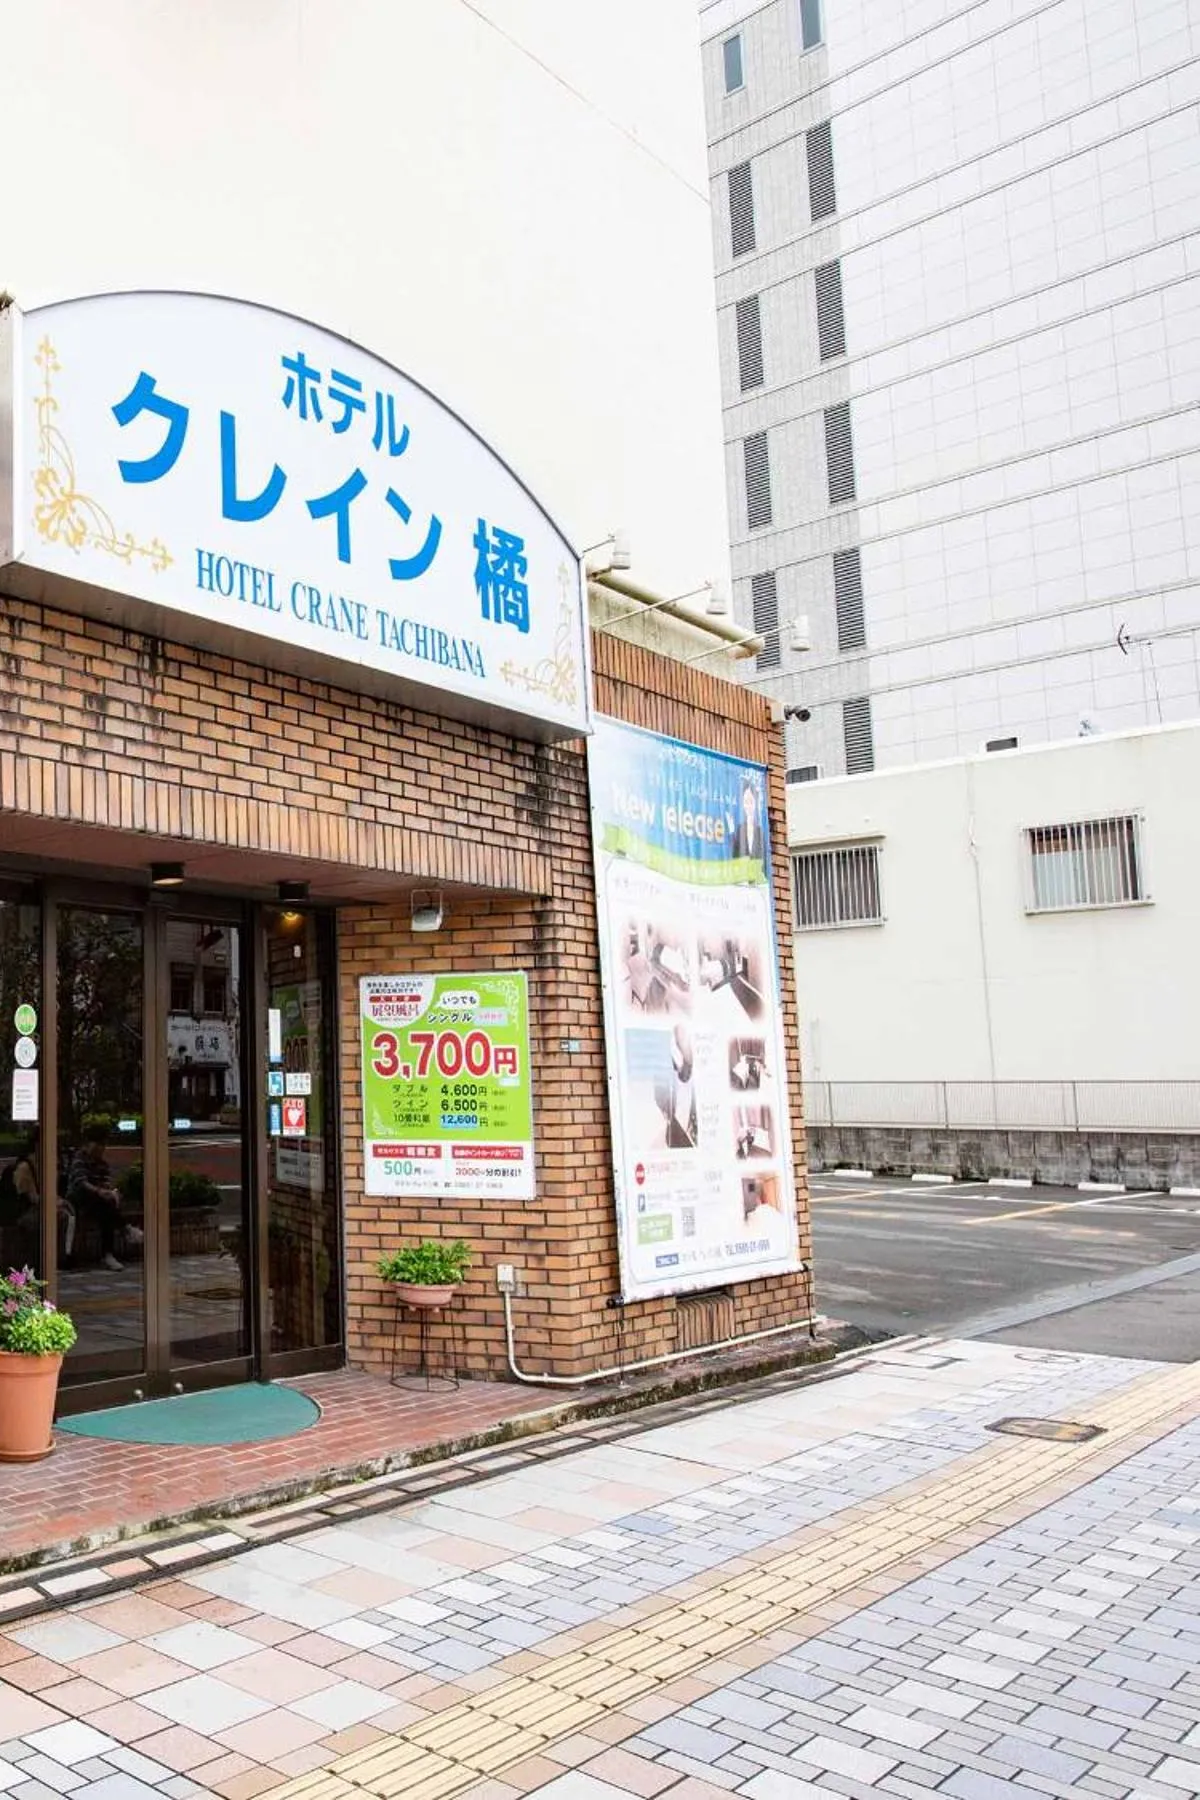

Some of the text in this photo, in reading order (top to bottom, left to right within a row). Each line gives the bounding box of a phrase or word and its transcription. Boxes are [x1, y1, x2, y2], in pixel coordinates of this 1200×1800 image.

[281, 352, 410, 457] ホテル
[196, 548, 487, 679] HOTEL CRANE TACHIBANA
[612, 781, 655, 825] New
[428, 1012, 473, 1024] シングル
